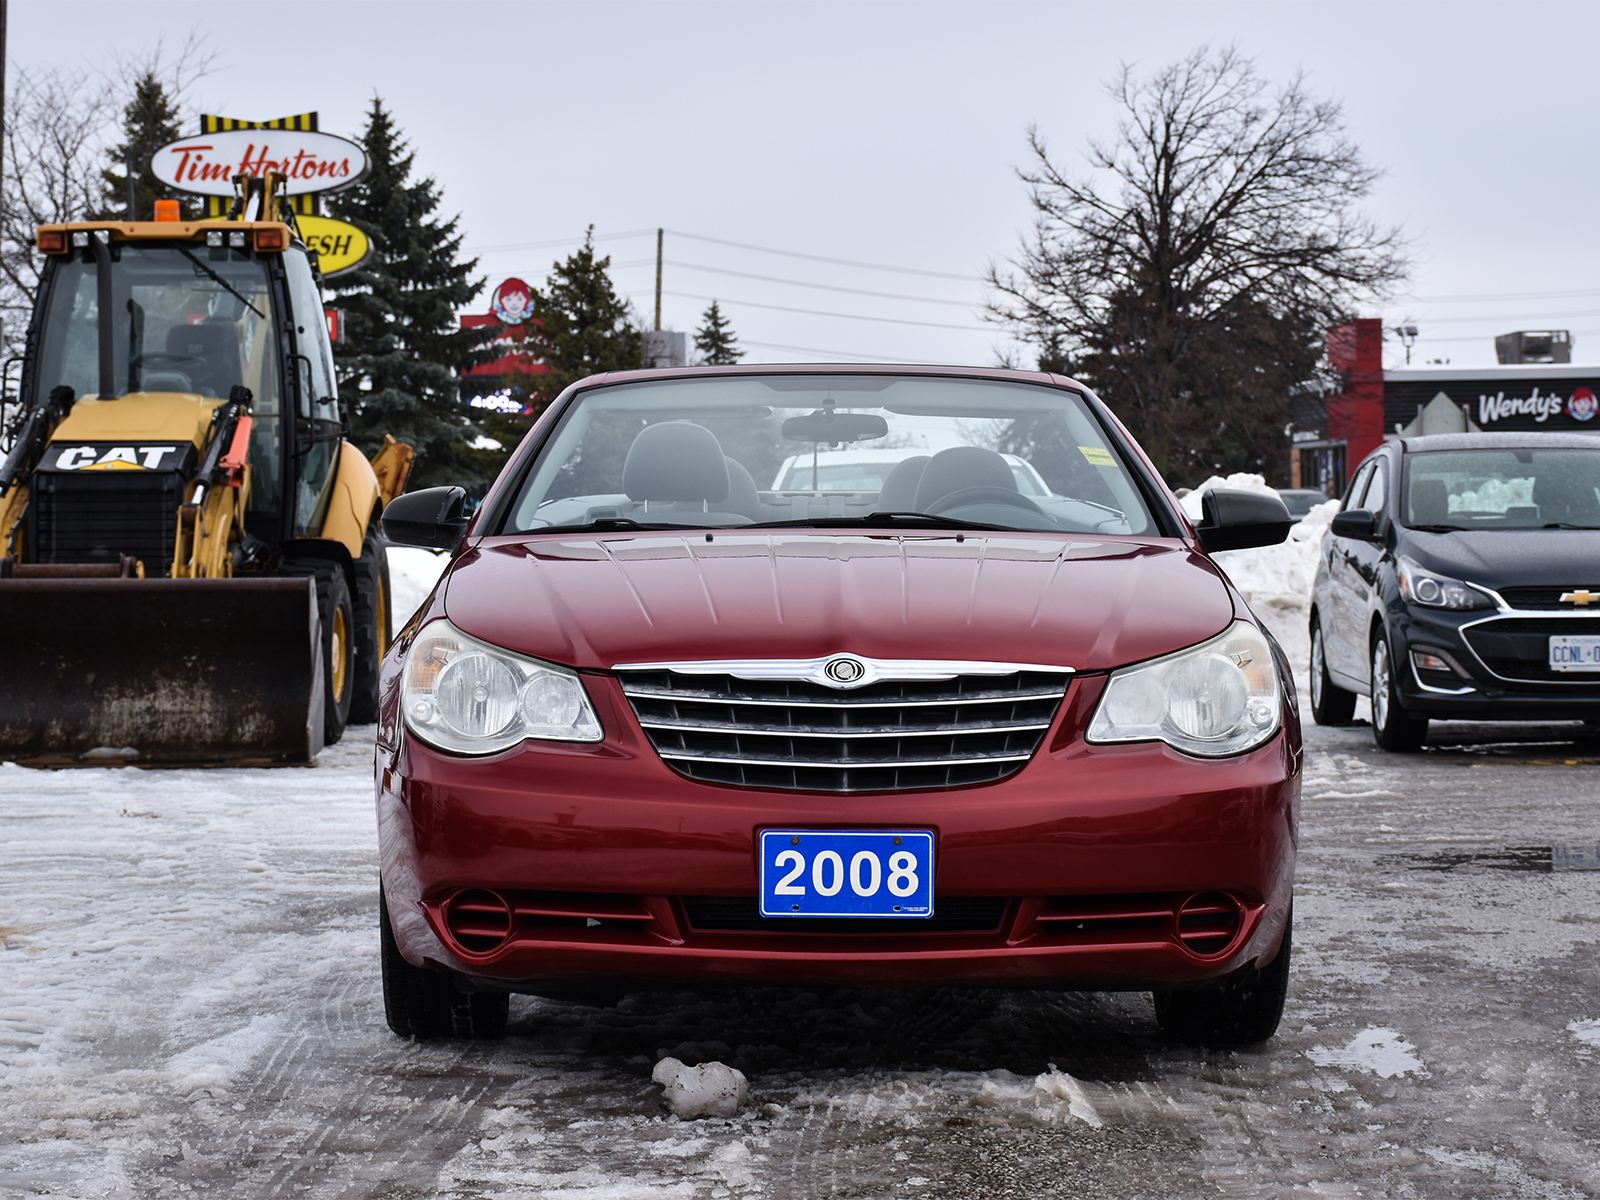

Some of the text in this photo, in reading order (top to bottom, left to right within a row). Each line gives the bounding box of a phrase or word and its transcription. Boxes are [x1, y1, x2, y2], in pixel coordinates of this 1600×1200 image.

[171, 143, 349, 183] Tim Hortons
[1479, 387, 1562, 424] Wendy's
[56, 446, 176, 470] CAT
[774, 849, 919, 897] 2008
